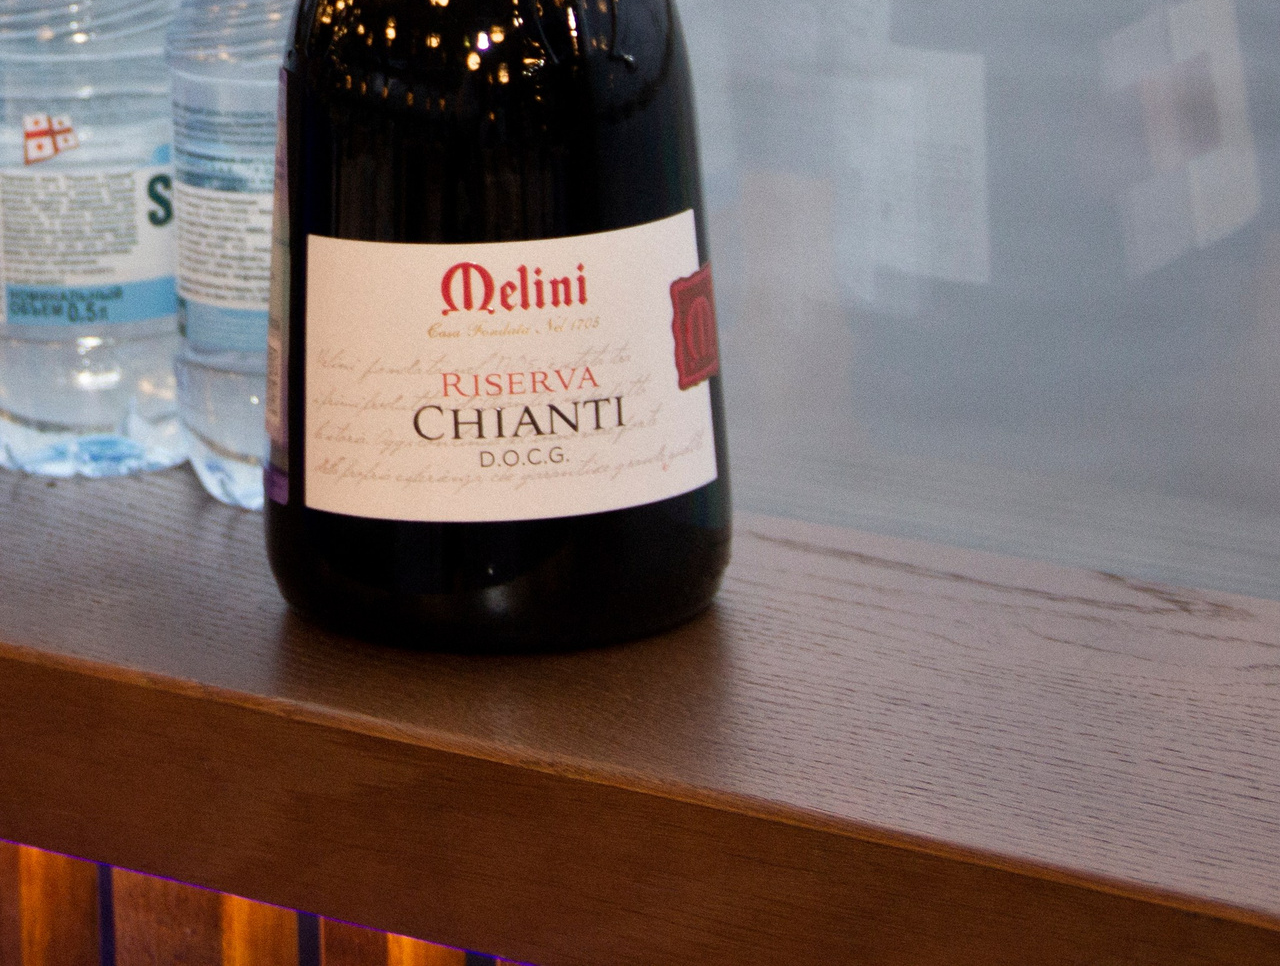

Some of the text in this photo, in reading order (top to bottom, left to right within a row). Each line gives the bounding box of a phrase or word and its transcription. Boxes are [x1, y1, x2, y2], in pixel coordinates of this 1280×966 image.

[441, 261, 588, 317] Melini
[427, 322, 461, 339] Casa
[441, 365, 600, 398] RISERVA
[412, 395, 626, 442] CHIANTI
[479, 446, 571, 468] D.O.C.G.
